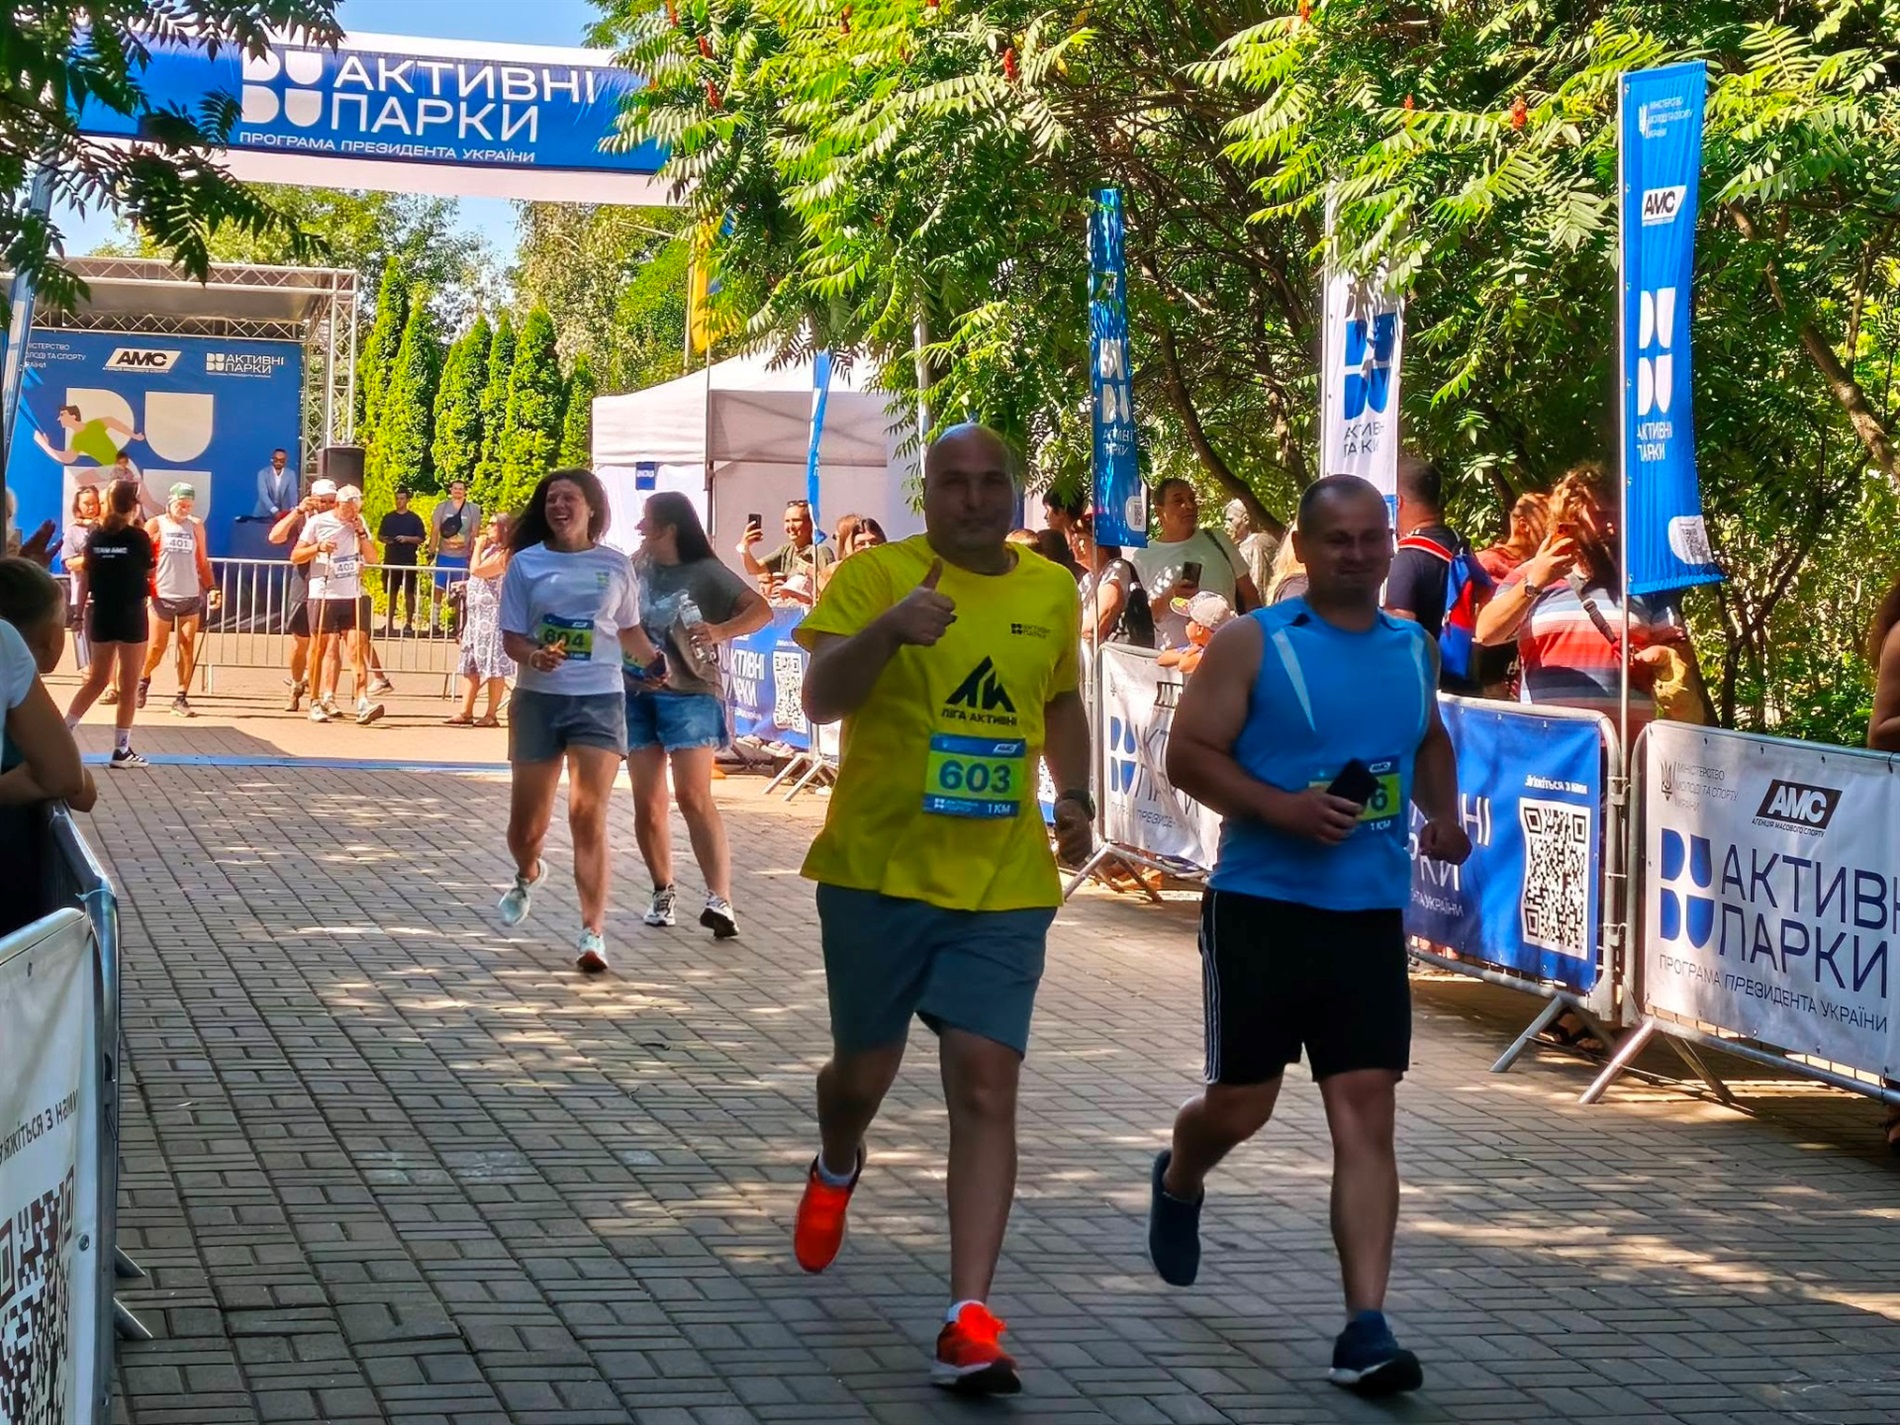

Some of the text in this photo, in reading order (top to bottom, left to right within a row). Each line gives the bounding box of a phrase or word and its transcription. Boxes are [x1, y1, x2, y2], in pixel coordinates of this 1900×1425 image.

[333, 54, 596, 105] АКТИВНІ
[331, 92, 538, 143] ПАРКИ
[239, 132, 536, 163] ПРОГРАМА ПРЕЗИДЕНТА УКРАЇНИ
[116, 351, 167, 367] АМС
[225, 362, 271, 374] ПАРКИ
[226, 354, 284, 366] АКТИВНІ
[169, 538, 188, 548] 401
[942, 708, 967, 720] ЛІГА
[938, 759, 1011, 794] 603
[1767, 785, 1827, 823] АМС
[1719, 902, 1888, 999] ПАРКИ
[1659, 954, 1888, 1034] ПРОГРАМА ПРЕЗИДЕНТА УКРАЇНИ
